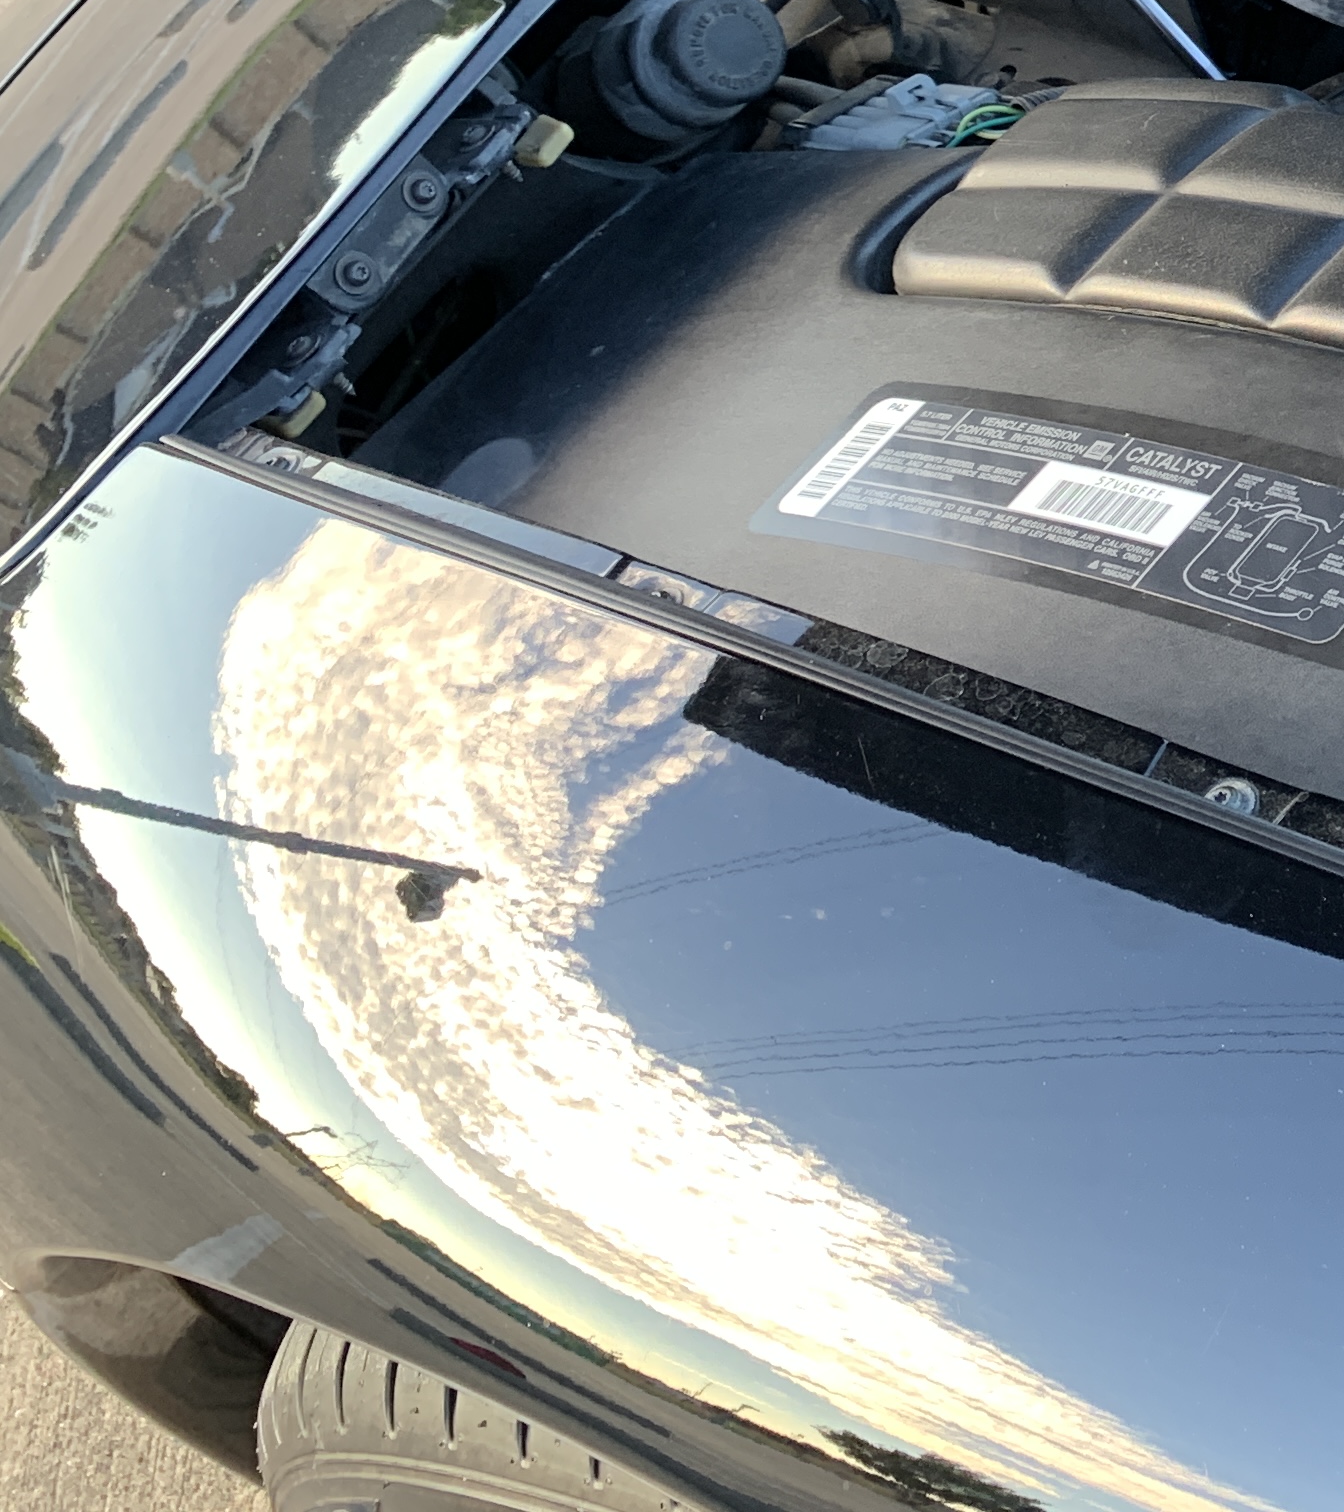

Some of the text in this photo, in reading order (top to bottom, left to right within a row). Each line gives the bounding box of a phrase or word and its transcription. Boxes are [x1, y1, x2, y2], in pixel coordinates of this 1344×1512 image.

[955, 424, 1007, 439] CONTROL
[1009, 433, 1088, 454] INFORMATION
[980, 416, 1082, 441] VEHICLE EMISSION
[955, 435, 1076, 461] GENERAL MOTORS CORPORATION
[875, 455, 1021, 486] MANUAL AND MAINTENANCE SCHEDULE
[894, 451, 945, 463] ADJUSTMENTS
[994, 467, 1028, 478] SERVICE
[1125, 446, 1222, 480] CATALYST
[1095, 476, 1166, 499] 57VAGFFF
[864, 488, 897, 501] VEHICLE
[897, 494, 943, 509] CONFORMS
[957, 505, 972, 514] U.S.
[975, 509, 992, 518] EPA
[1019, 519, 1079, 538] REGULATIONS
[1080, 533, 1101, 542] AND
[1102, 538, 1156, 557] CALIFORNIA
[886, 498, 932, 514] APPLICABLE
[960, 513, 1010, 532] MODEL-YEAR
[1009, 525, 1029, 534] NEW
[1028, 529, 1045, 538] LEV
[1045, 532, 1095, 550] PASSENGER
[1122, 552, 1142, 562] OBD
[1283, 586, 1314, 600] THROTTLE
